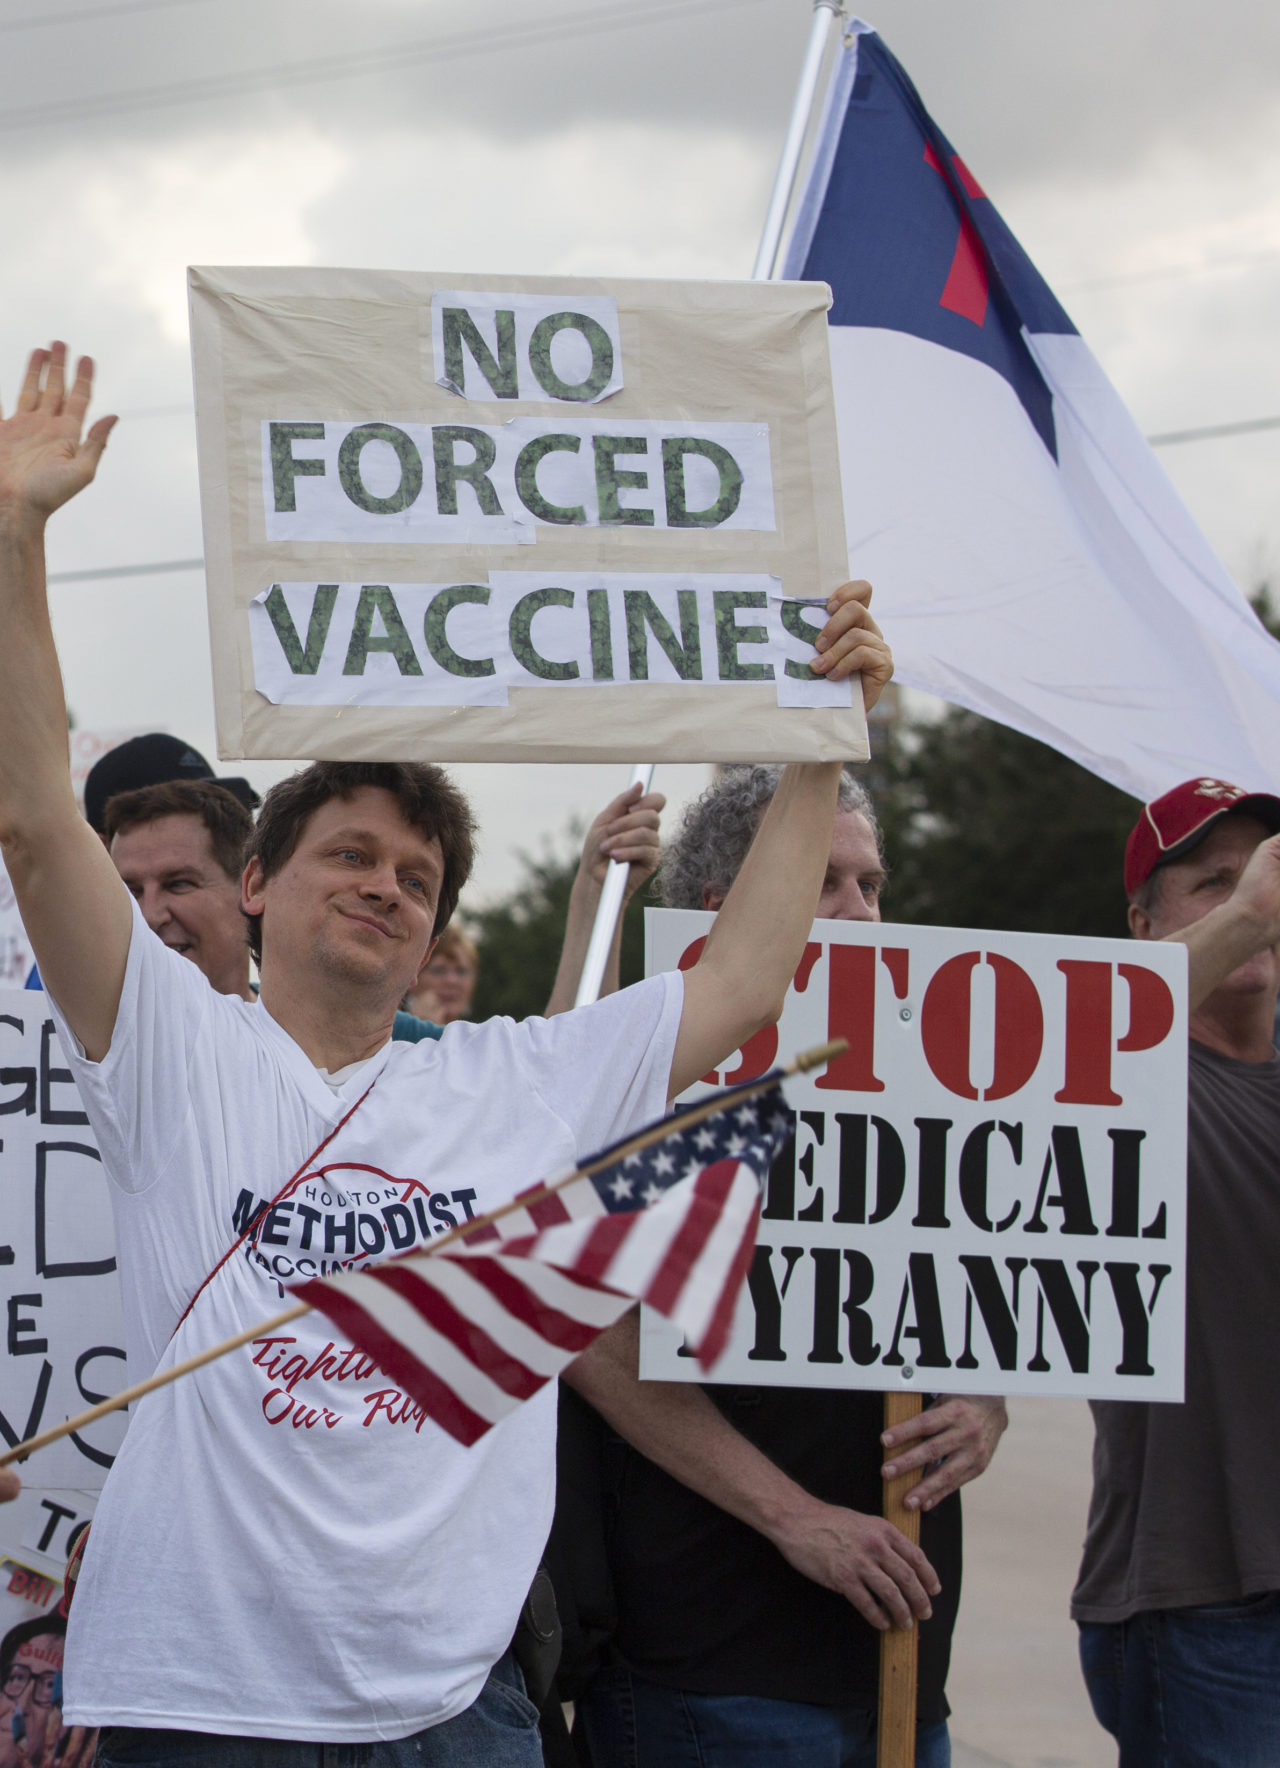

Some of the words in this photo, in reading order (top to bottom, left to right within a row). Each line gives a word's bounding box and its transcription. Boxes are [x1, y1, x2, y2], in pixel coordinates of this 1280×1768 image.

[441, 307, 615, 401] NO
[269, 422, 746, 529] FORCED
[264, 584, 832, 682] VACCINES
[675, 1103, 1168, 1240] EDICAL
[232, 1187, 478, 1256] METHODIST
[677, 1245, 1172, 1377] YRANNY
[262, 1388, 344, 1429] Our
[6, 1569, 55, 1608] Bill
